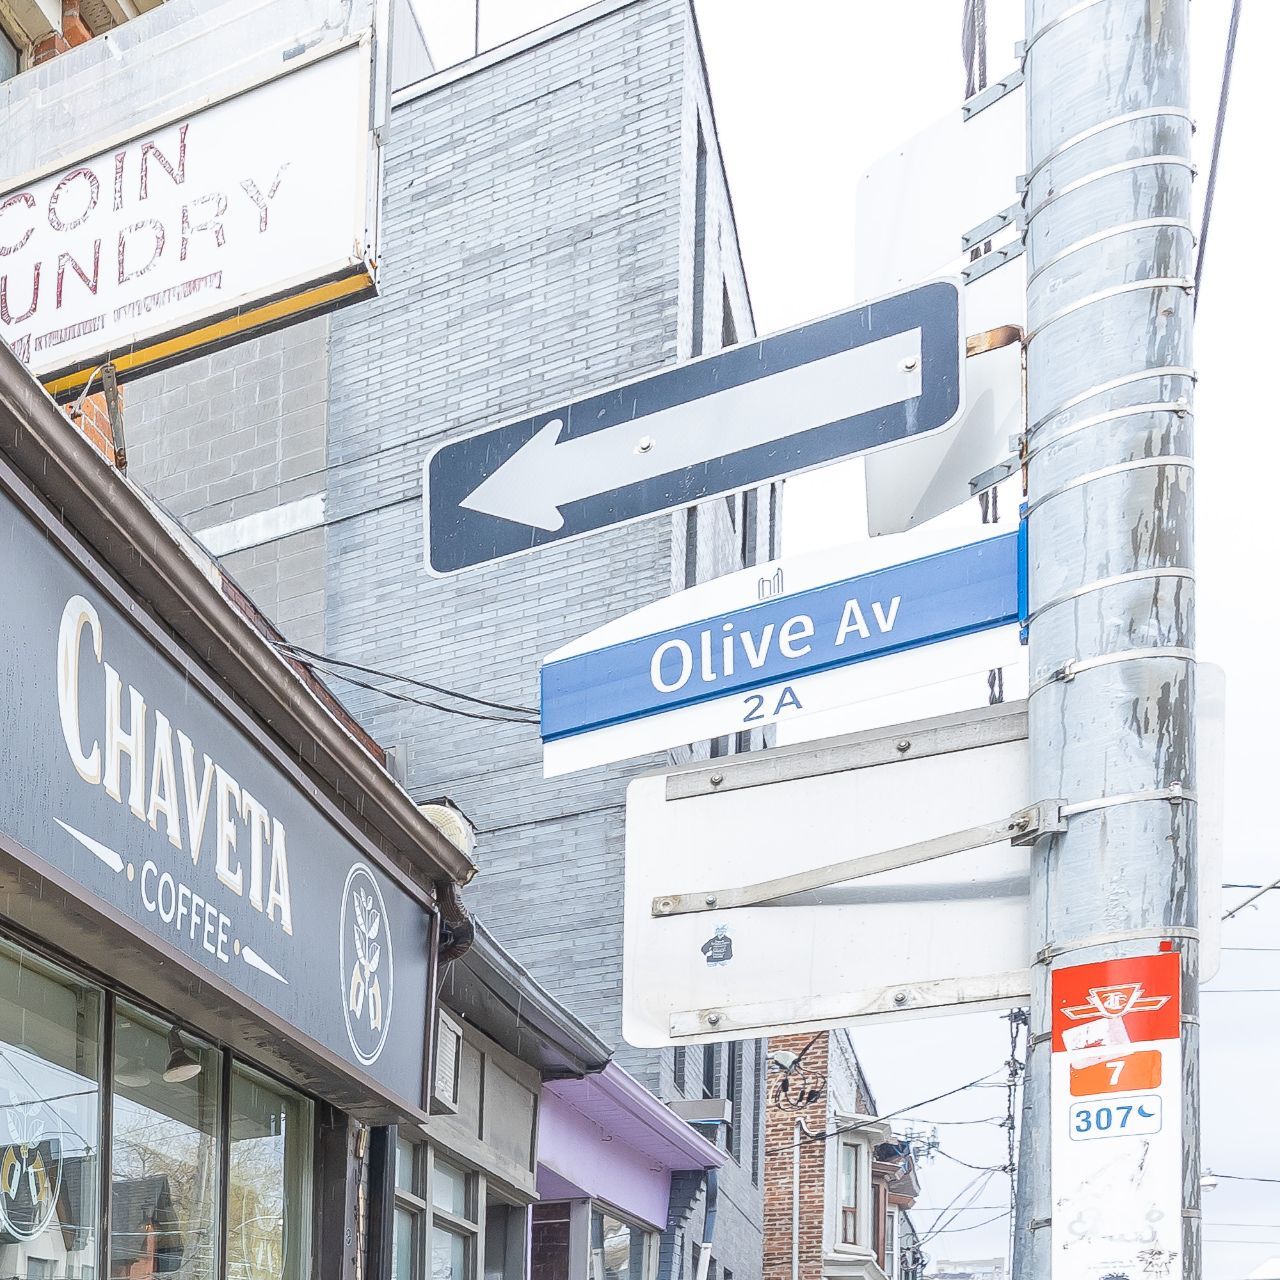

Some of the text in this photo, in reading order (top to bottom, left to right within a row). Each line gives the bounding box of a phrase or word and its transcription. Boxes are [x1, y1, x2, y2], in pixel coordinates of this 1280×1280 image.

[650, 595, 903, 694] Olive Av
[56, 594, 295, 937] CHAVETA
[139, 859, 232, 965] COFFEE
[1075, 1105, 1133, 1133] 307
[1105, 1060, 1127, 1086] 7
